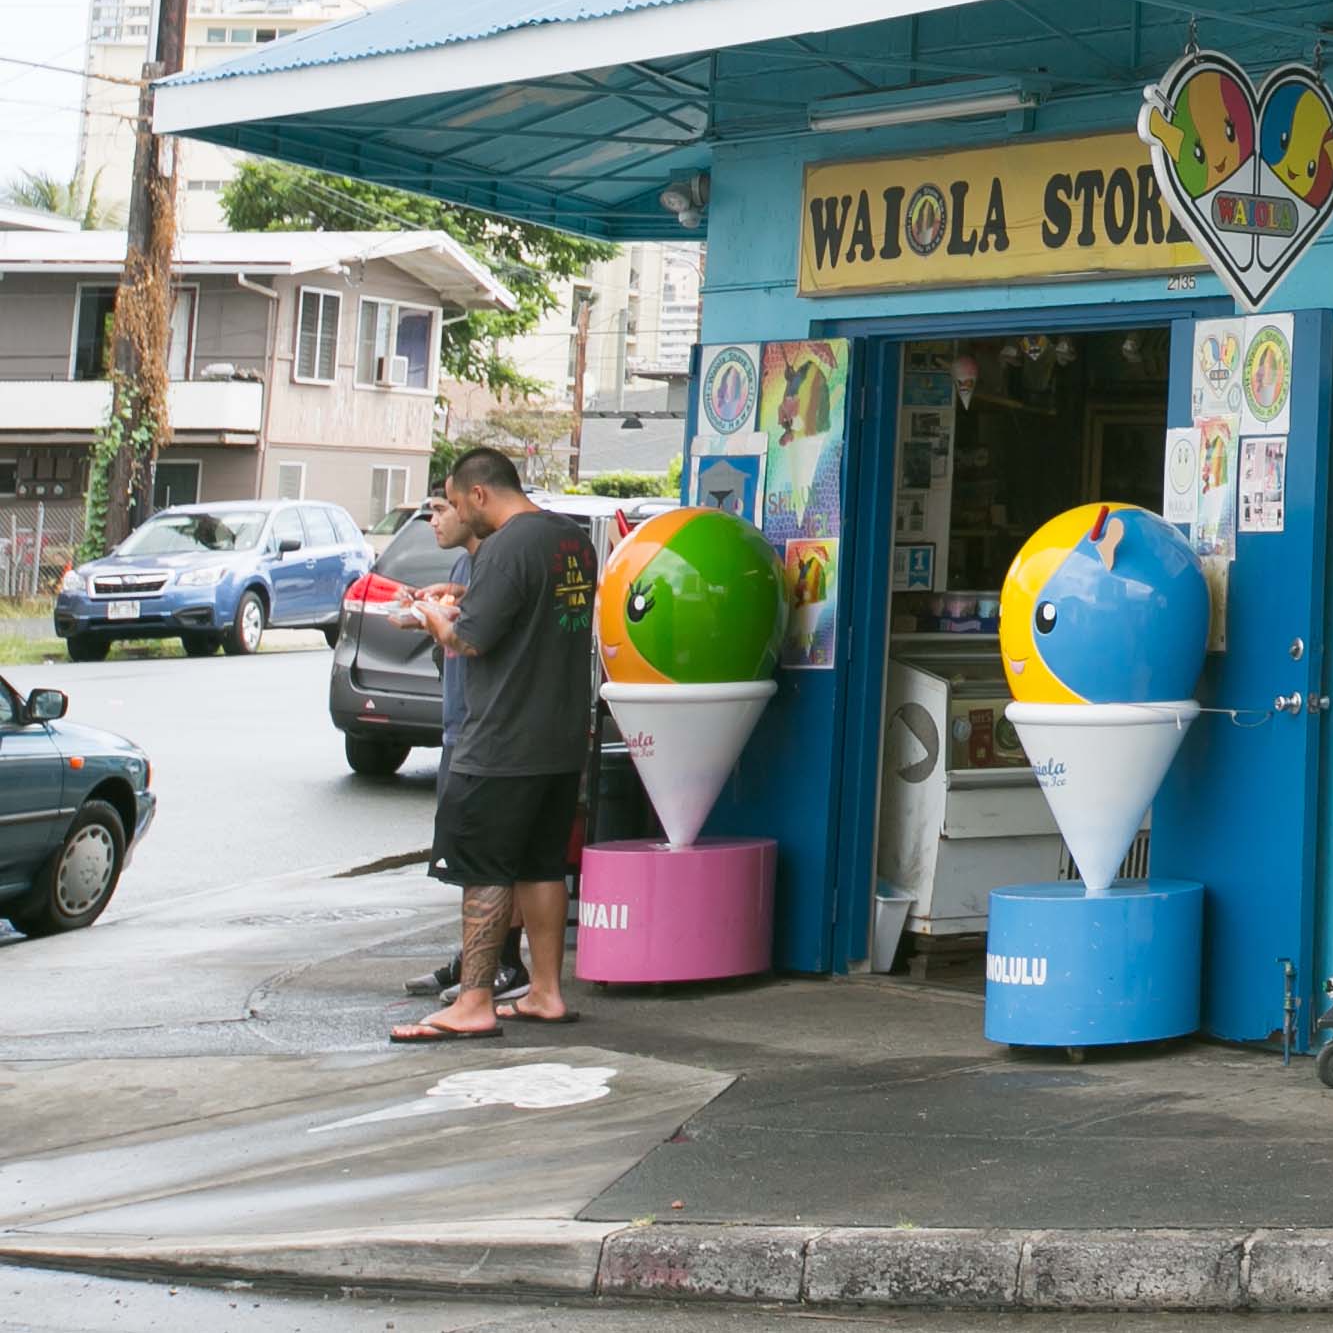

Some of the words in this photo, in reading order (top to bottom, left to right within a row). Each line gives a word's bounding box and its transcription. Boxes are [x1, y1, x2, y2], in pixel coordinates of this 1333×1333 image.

[810, 178, 1009, 270] WAIOLA
[1218, 197, 1293, 230] WAIOLA
[1168, 274, 1196, 291] 2135
